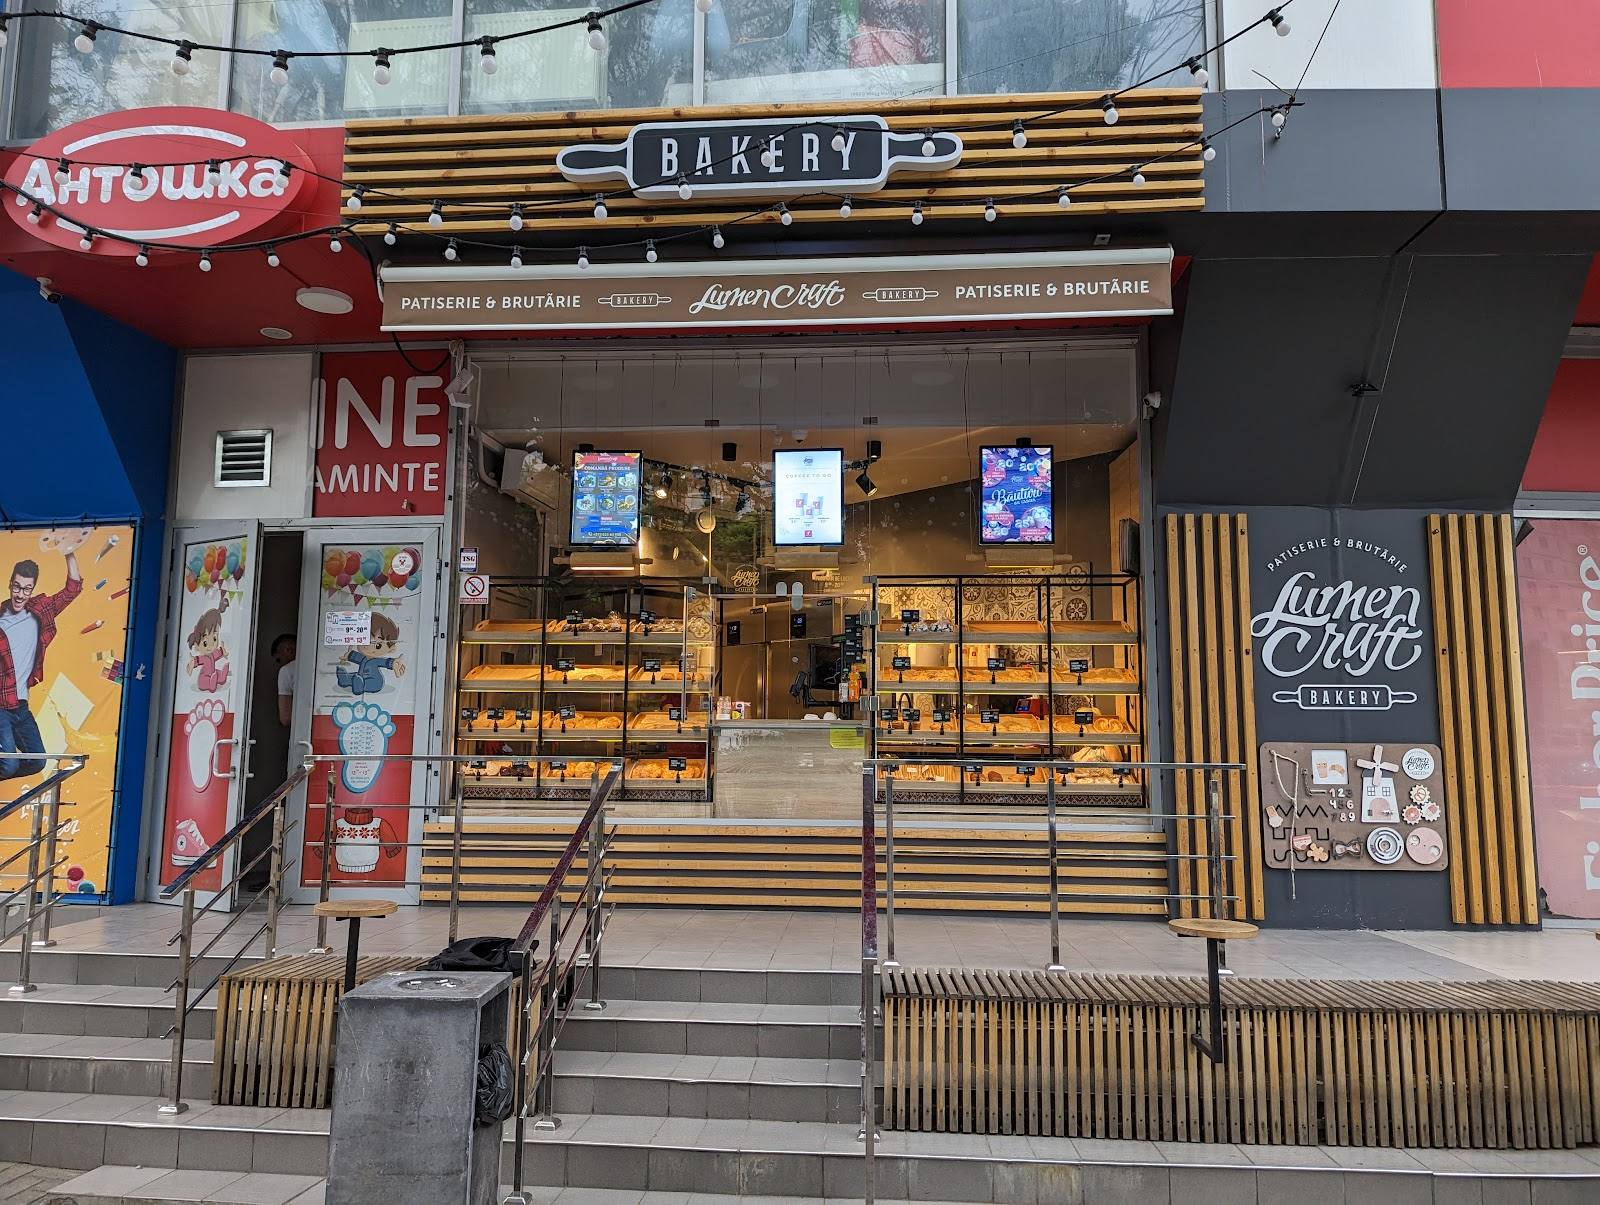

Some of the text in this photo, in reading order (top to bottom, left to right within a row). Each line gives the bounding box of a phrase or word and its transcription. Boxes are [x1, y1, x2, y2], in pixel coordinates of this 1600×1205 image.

[660, 132, 856, 177] BAKERY
[15, 157, 289, 206] Антошка
[401, 296, 481, 310] PATISERIE
[486, 296, 497, 309] &
[616, 295, 654, 306] BAKERY
[882, 290, 921, 300] BAKERY
[955, 284, 1041, 299] PATISERIE
[1046, 283, 1058, 297] &
[1267, 538, 1327, 572] PATISERIE
[1333, 537, 1341, 547] &
[1250, 571, 1421, 638] Lumen
[1261, 614, 1423, 677] Craft
[1310, 690, 1381, 706] BAKERY
